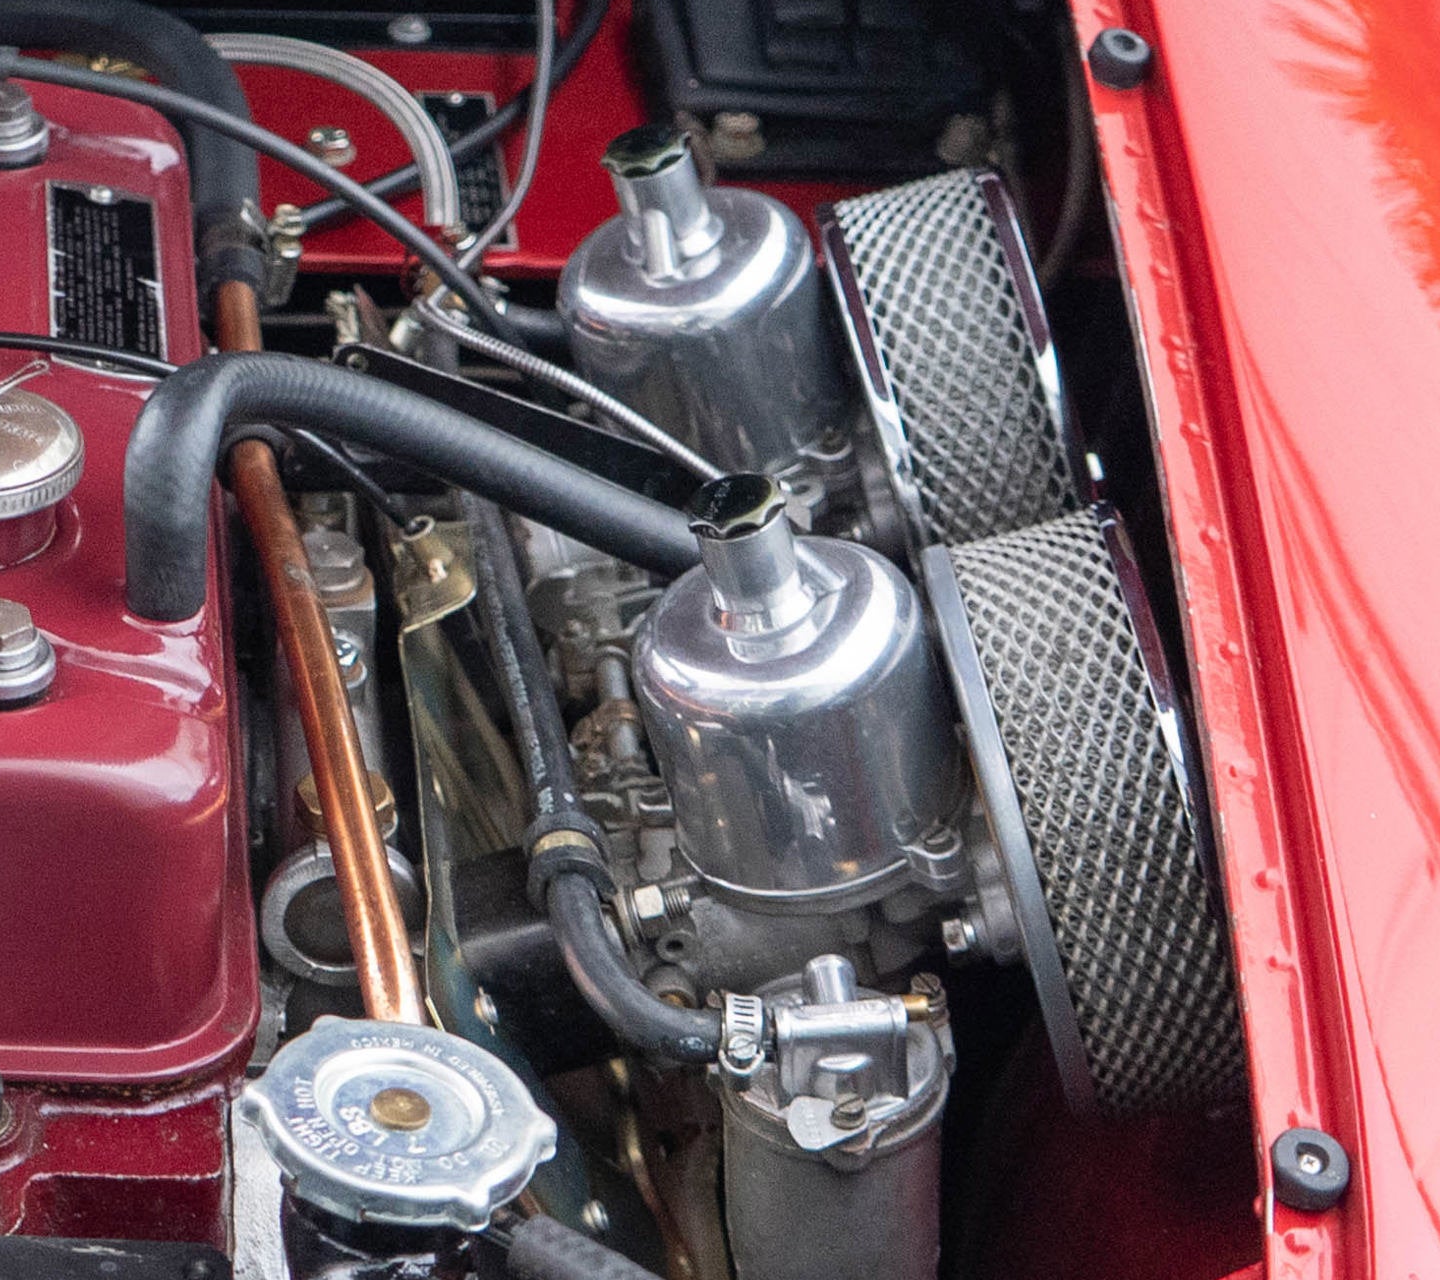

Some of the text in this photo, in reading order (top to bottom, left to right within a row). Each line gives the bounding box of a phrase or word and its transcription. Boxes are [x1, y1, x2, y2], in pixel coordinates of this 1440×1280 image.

[349, 1036, 416, 1049] MEXICO
[423, 1043, 443, 1058] IN
[293, 1076, 316, 1110] HOT
[305, 1116, 360, 1156] OPEN
[338, 1105, 428, 1155] 7 LBS
[284, 1115, 419, 1185] KEEP TIGHT
